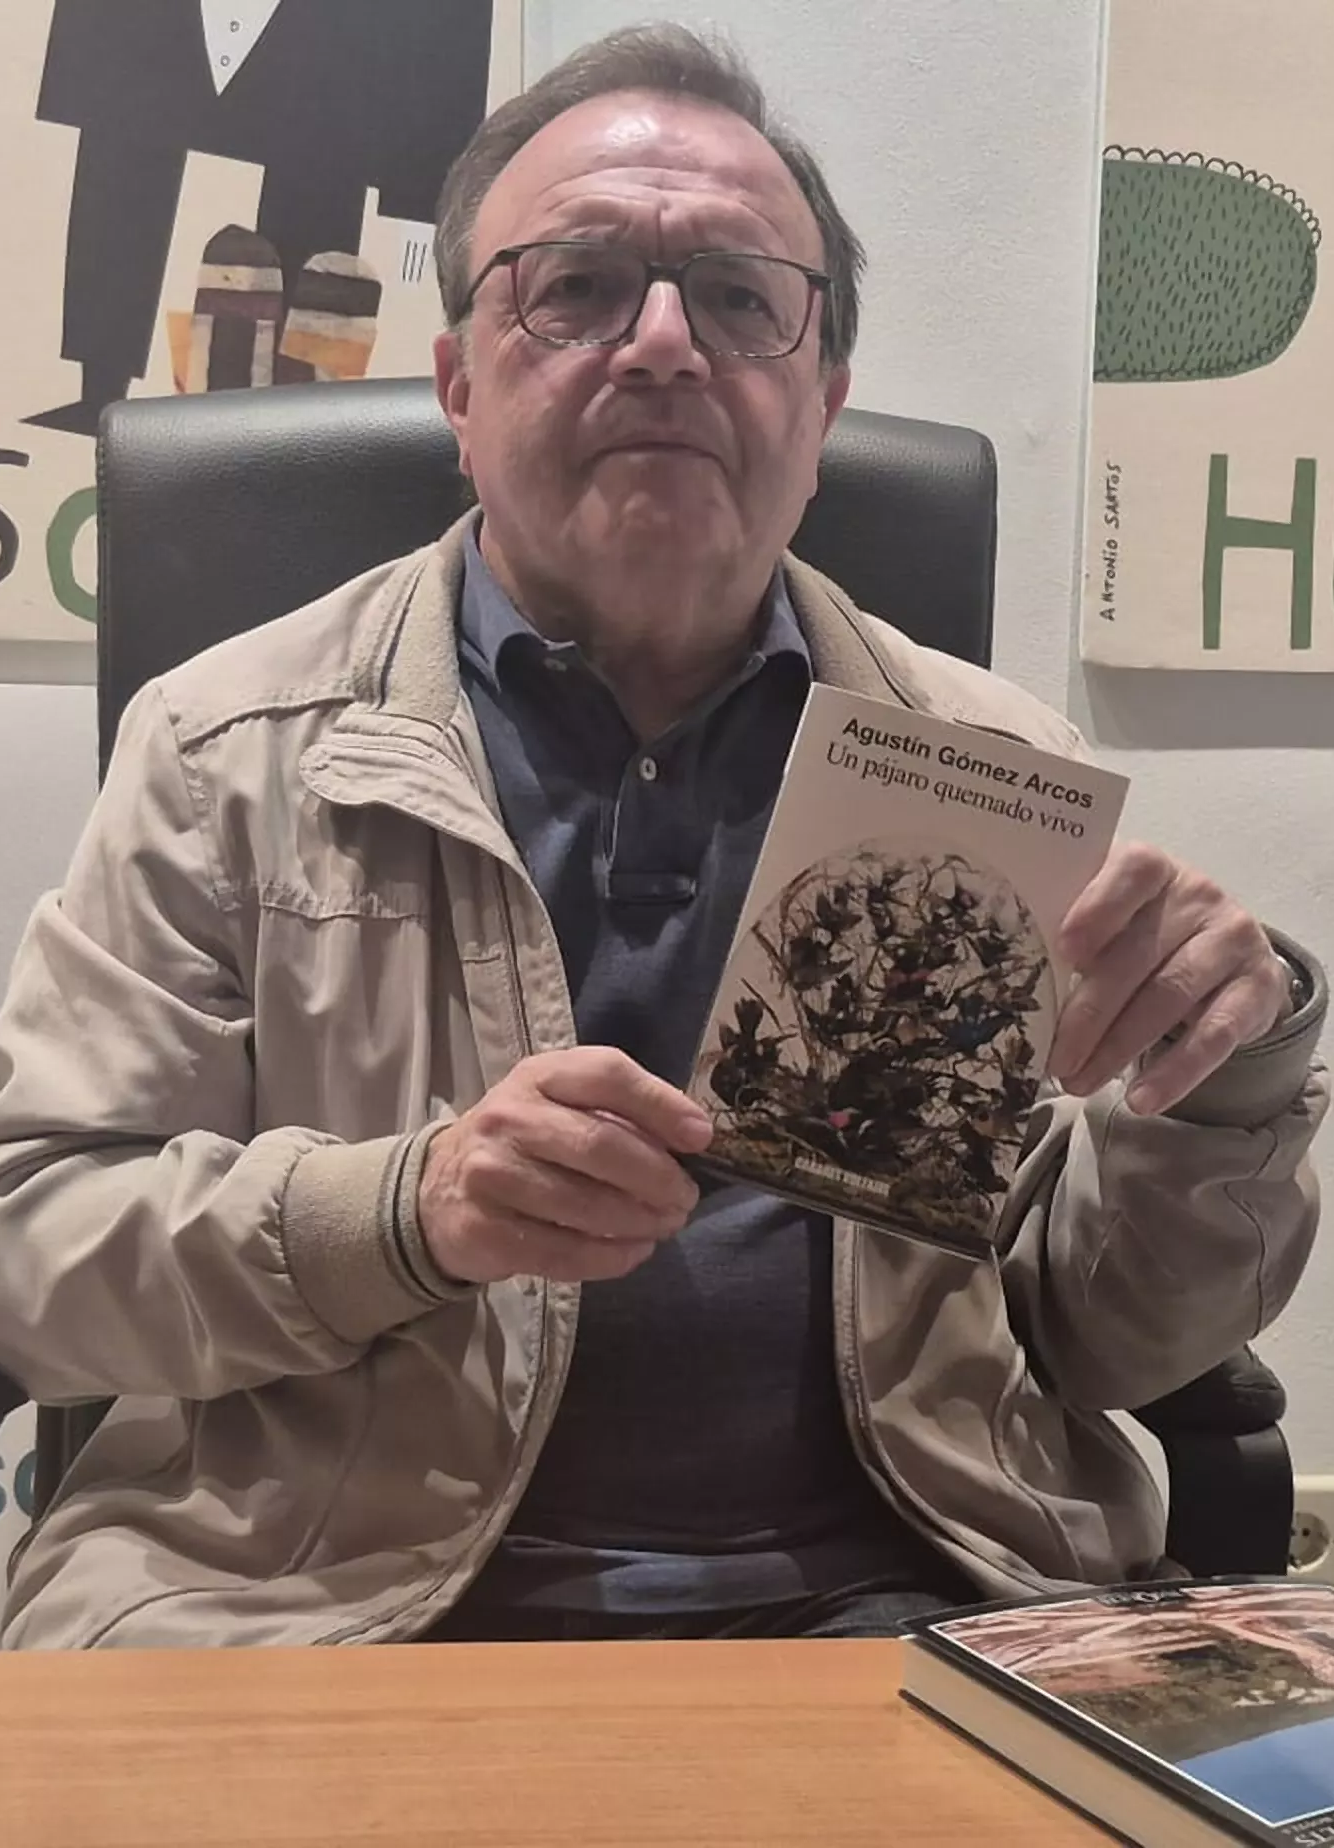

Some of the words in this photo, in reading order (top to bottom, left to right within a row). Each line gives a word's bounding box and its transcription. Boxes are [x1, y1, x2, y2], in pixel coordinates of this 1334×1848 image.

[1104, 460, 1122, 530] SANTOS
[826, 741, 858, 770] Un
[861, 755, 930, 792] pájaro
[933, 779, 1034, 824] quemado
[1039, 808, 1085, 839] vivo
[842, 718, 931, 760] Agustín
[937, 745, 1019, 786] Gómez
[1023, 773, 1094, 808] Arcos
